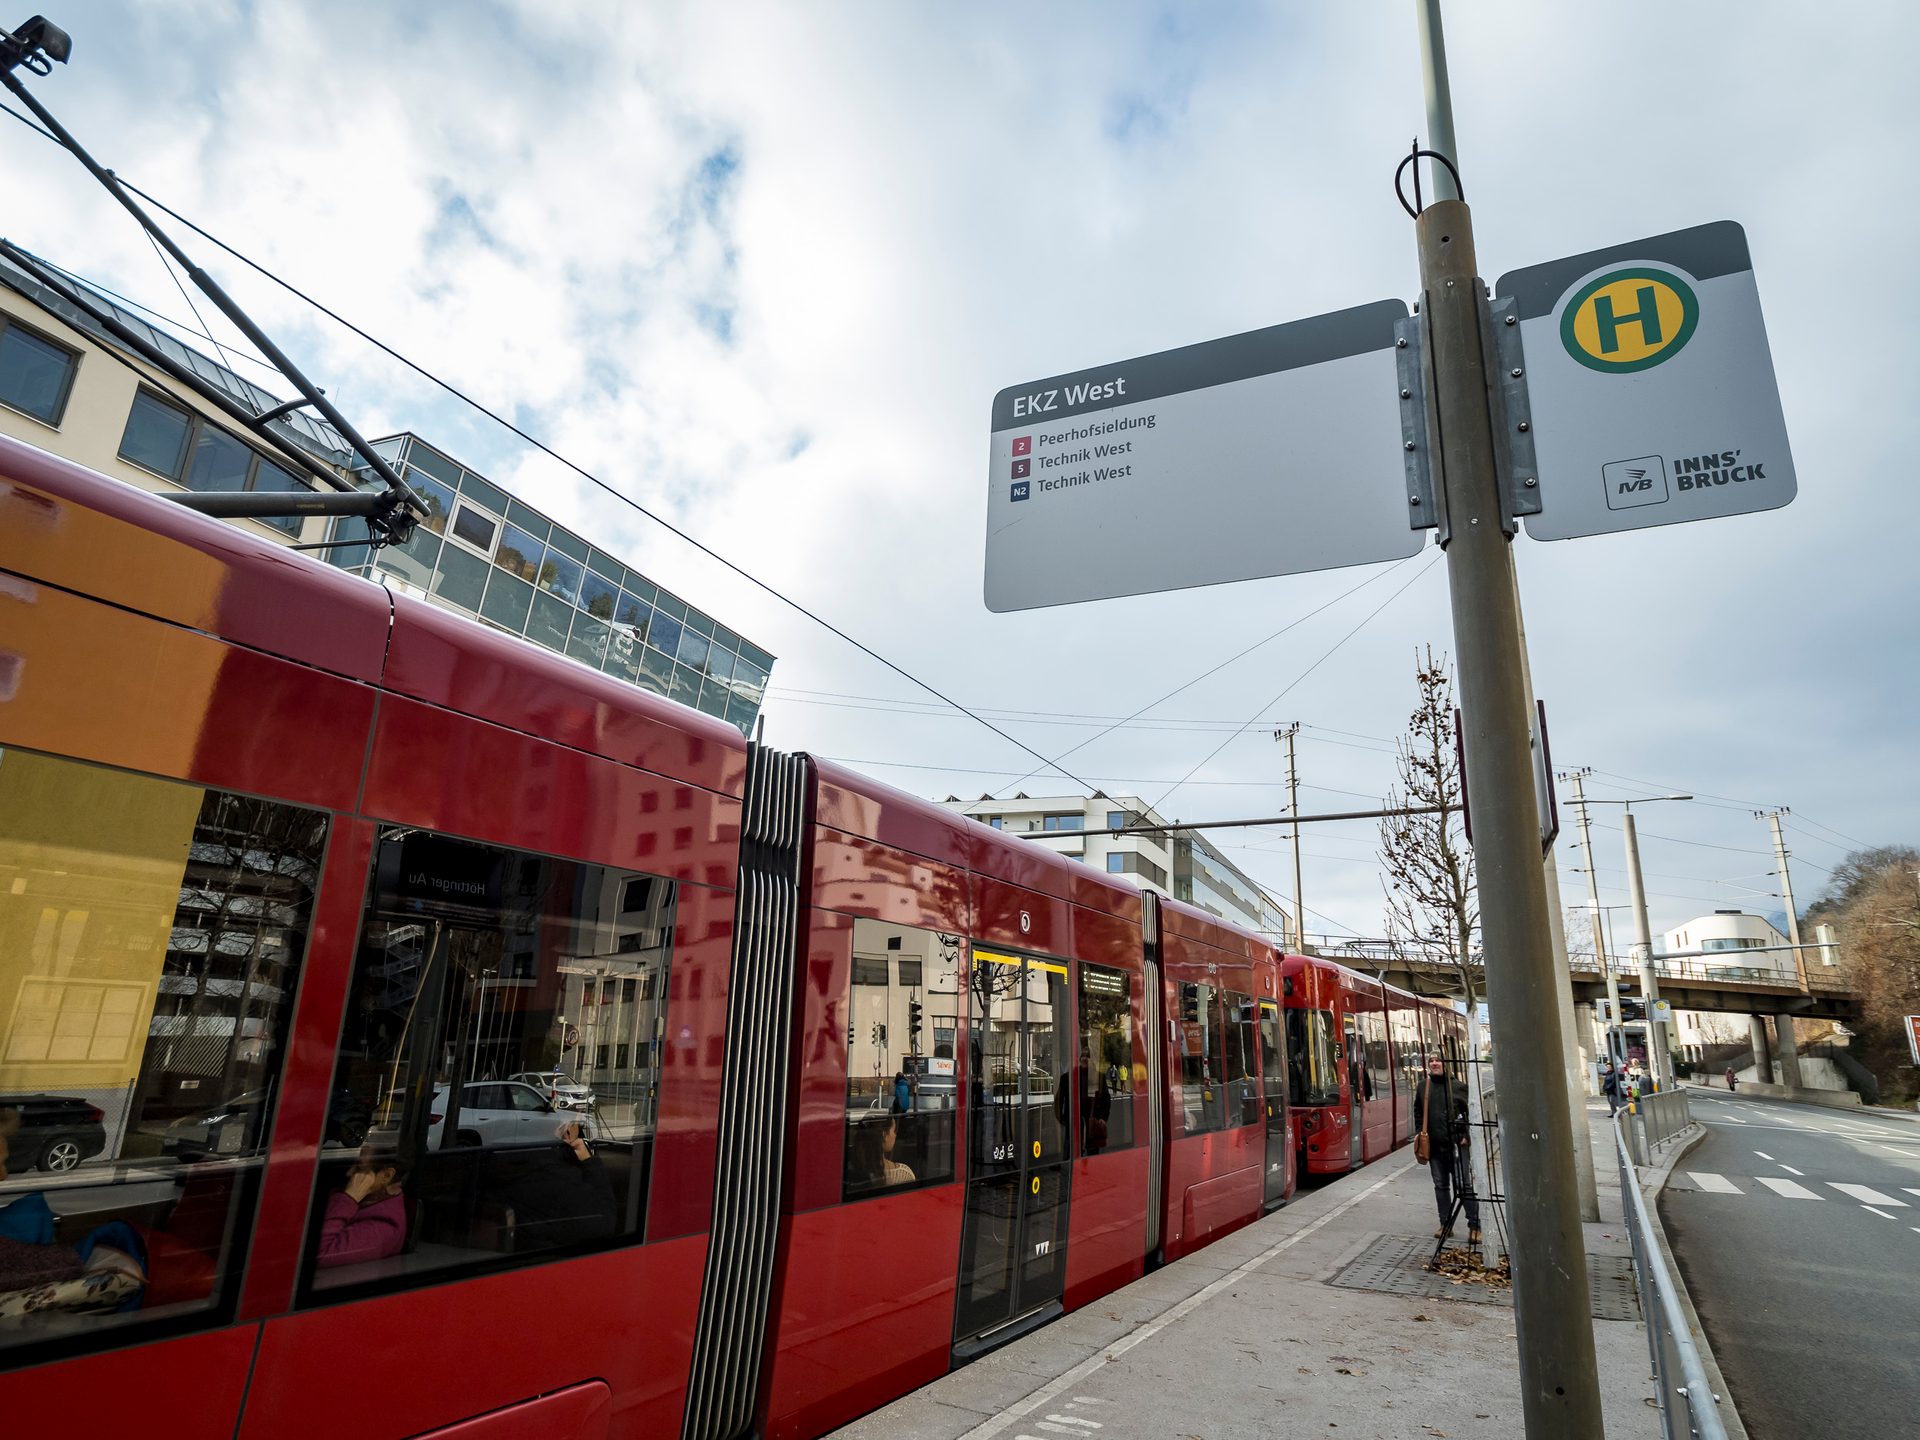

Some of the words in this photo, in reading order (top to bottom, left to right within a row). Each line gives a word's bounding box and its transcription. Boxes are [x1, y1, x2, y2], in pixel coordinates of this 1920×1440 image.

[1594, 286, 1662, 354] H
[1013, 389, 1058, 418] EKZ
[1064, 377, 1126, 406] West
[1018, 442, 1025, 451] 2
[1039, 414, 1156, 447] Peerhofsieldung
[1017, 464, 1024, 473] 5
[1038, 448, 1091, 469] Technik
[1094, 441, 1132, 458] West
[1013, 486, 1027, 497] N2
[1037, 471, 1090, 492] Technik
[1093, 464, 1132, 481] West
[1618, 478, 1653, 494] IVB
[1676, 463, 1767, 492] BRUCK
